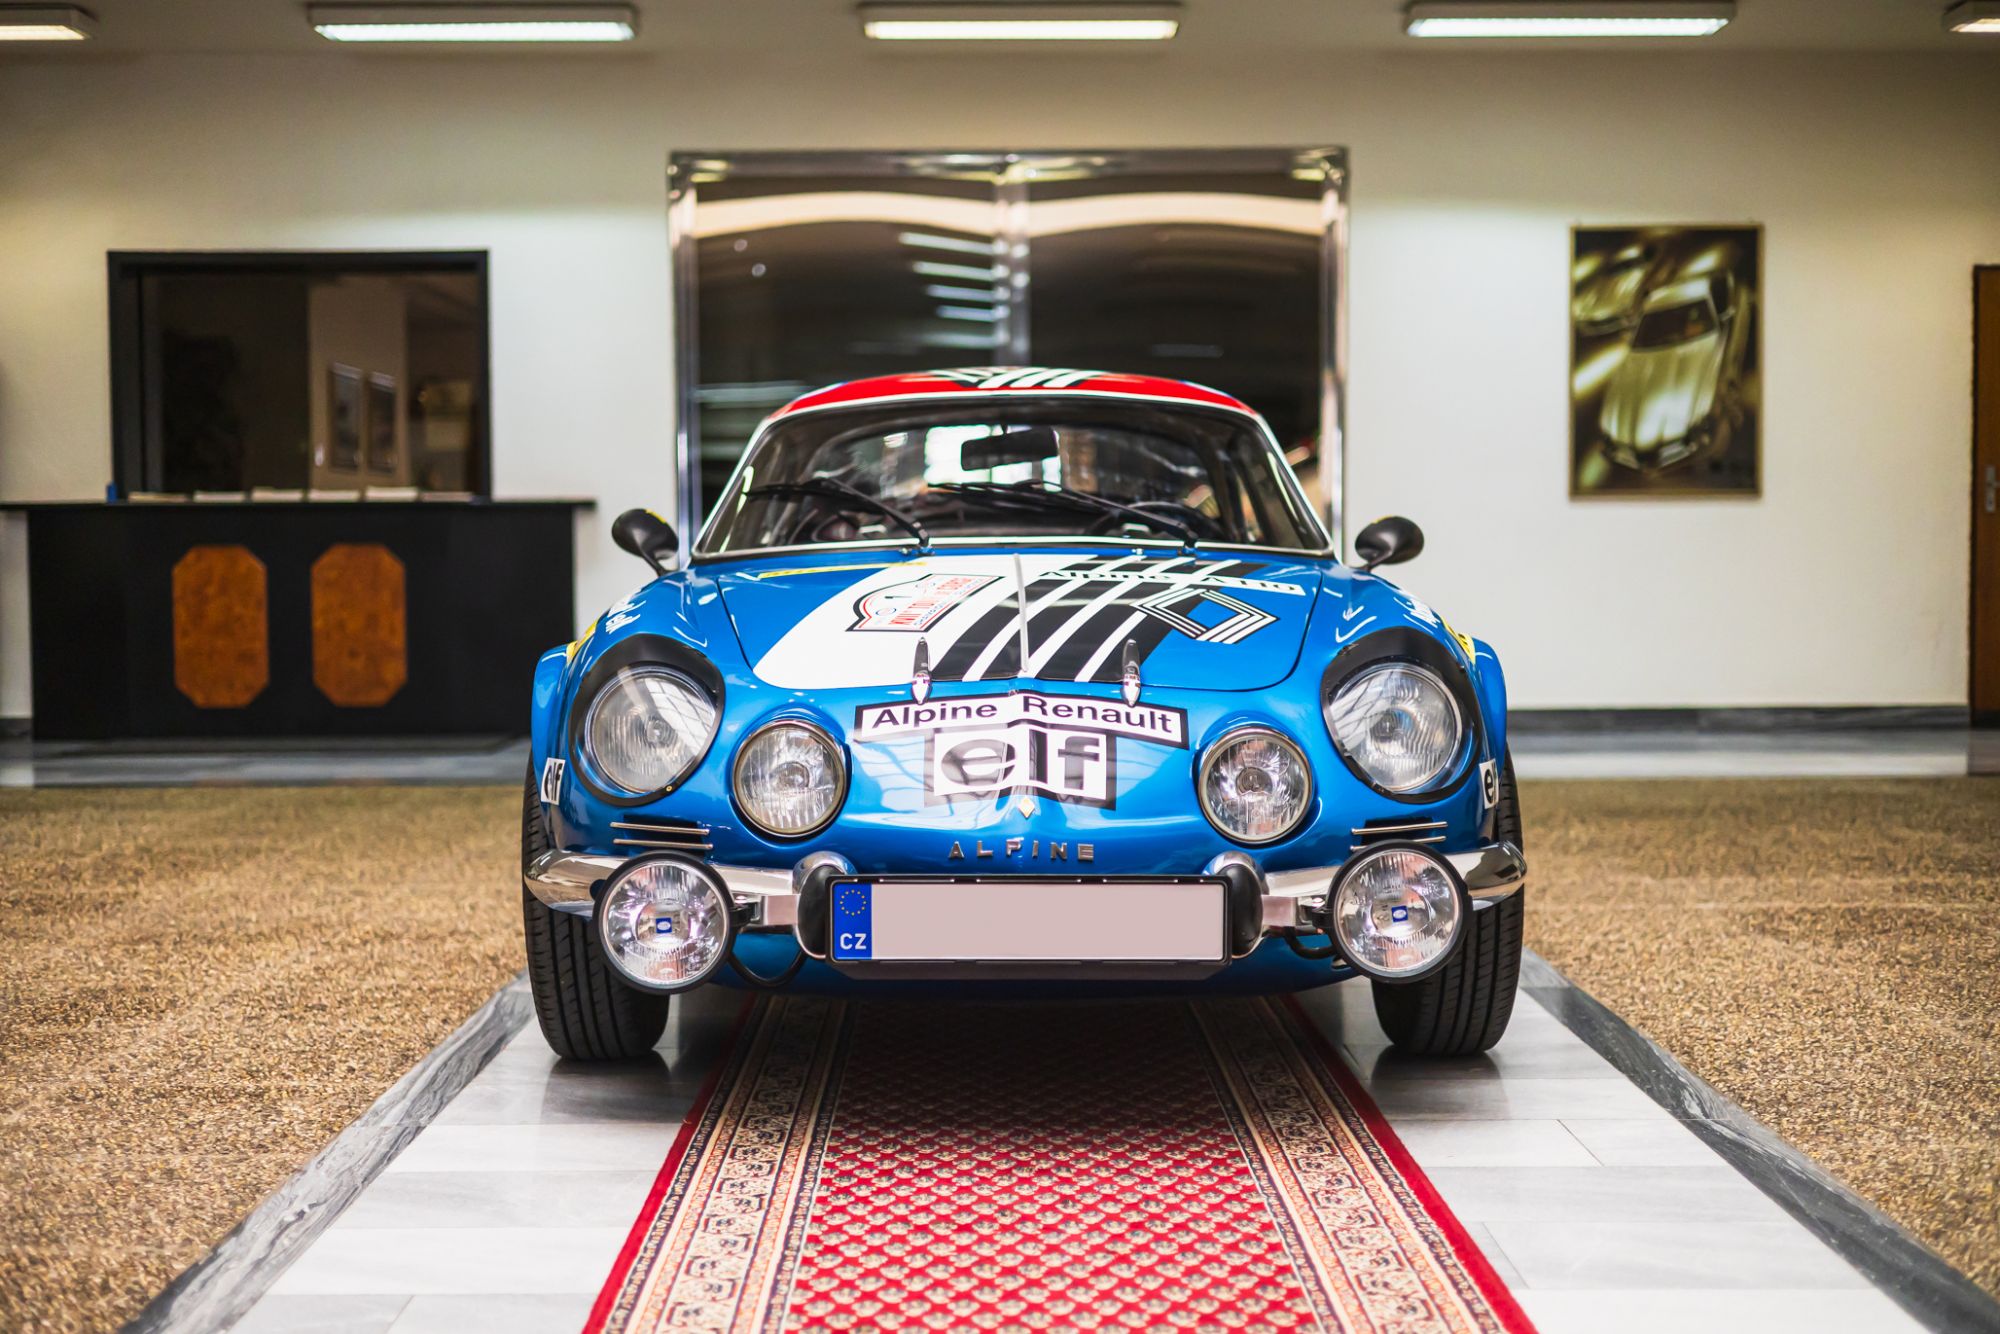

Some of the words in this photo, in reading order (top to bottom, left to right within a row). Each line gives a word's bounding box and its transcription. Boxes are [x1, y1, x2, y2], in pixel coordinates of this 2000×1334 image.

[872, 702, 998, 729] Alpine
[1022, 695, 1173, 733] Renault
[940, 728, 1100, 791] elf
[948, 837, 1094, 862] ALPINE
[840, 932, 867, 950] CZ
